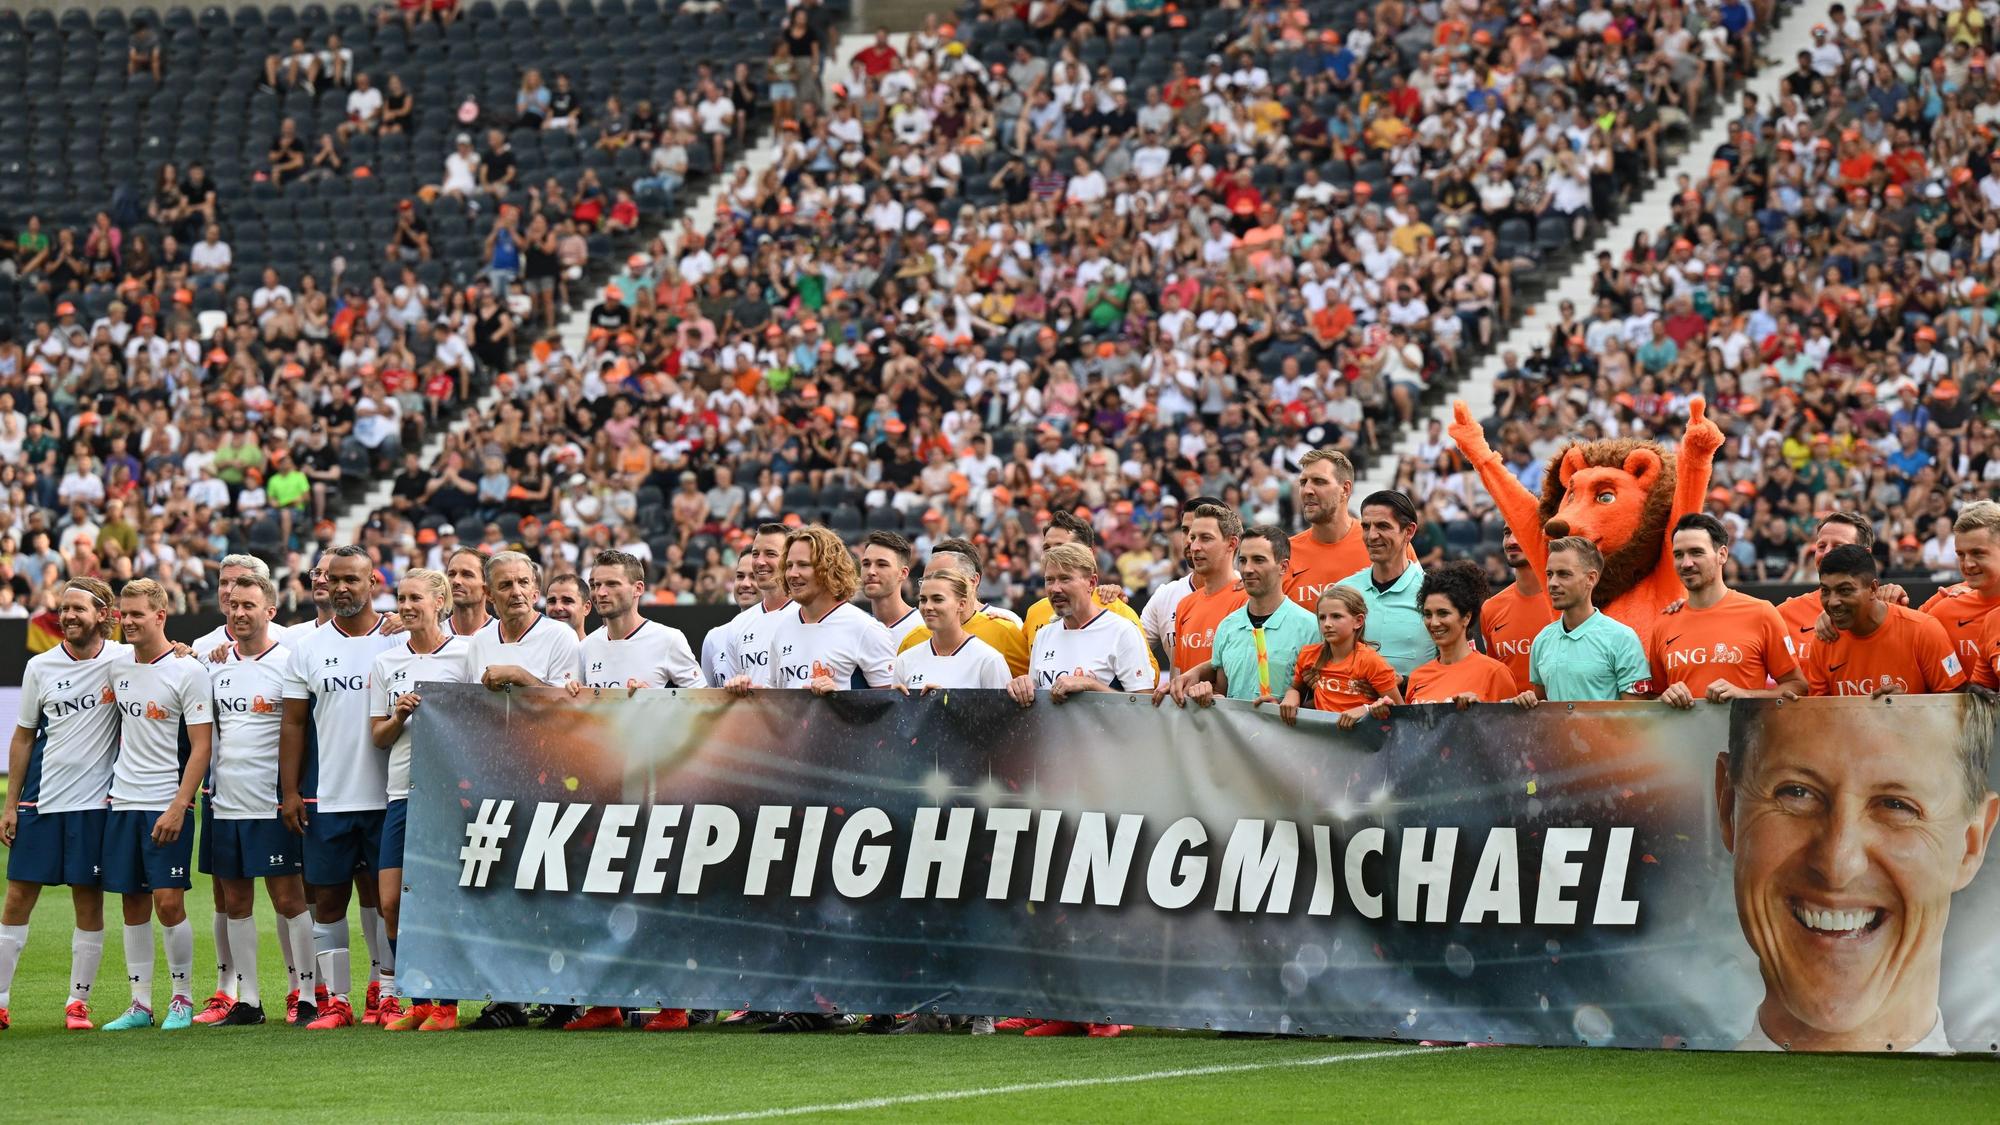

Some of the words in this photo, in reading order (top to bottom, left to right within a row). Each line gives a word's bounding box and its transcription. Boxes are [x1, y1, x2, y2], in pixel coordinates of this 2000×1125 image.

[1495, 638, 1531, 657] ING
[1959, 639, 1981, 657] IN
[739, 650, 769, 670] ING
[1667, 647, 1707, 670] ING
[323, 675, 363, 692] ING
[1317, 676, 1340, 692] NG
[1836, 678, 1874, 697] ING
[54, 694, 97, 717] ING
[118, 701, 142, 717] NG
[458, 799, 1640, 925] #KEEPFIGHTINGMICHAEL
